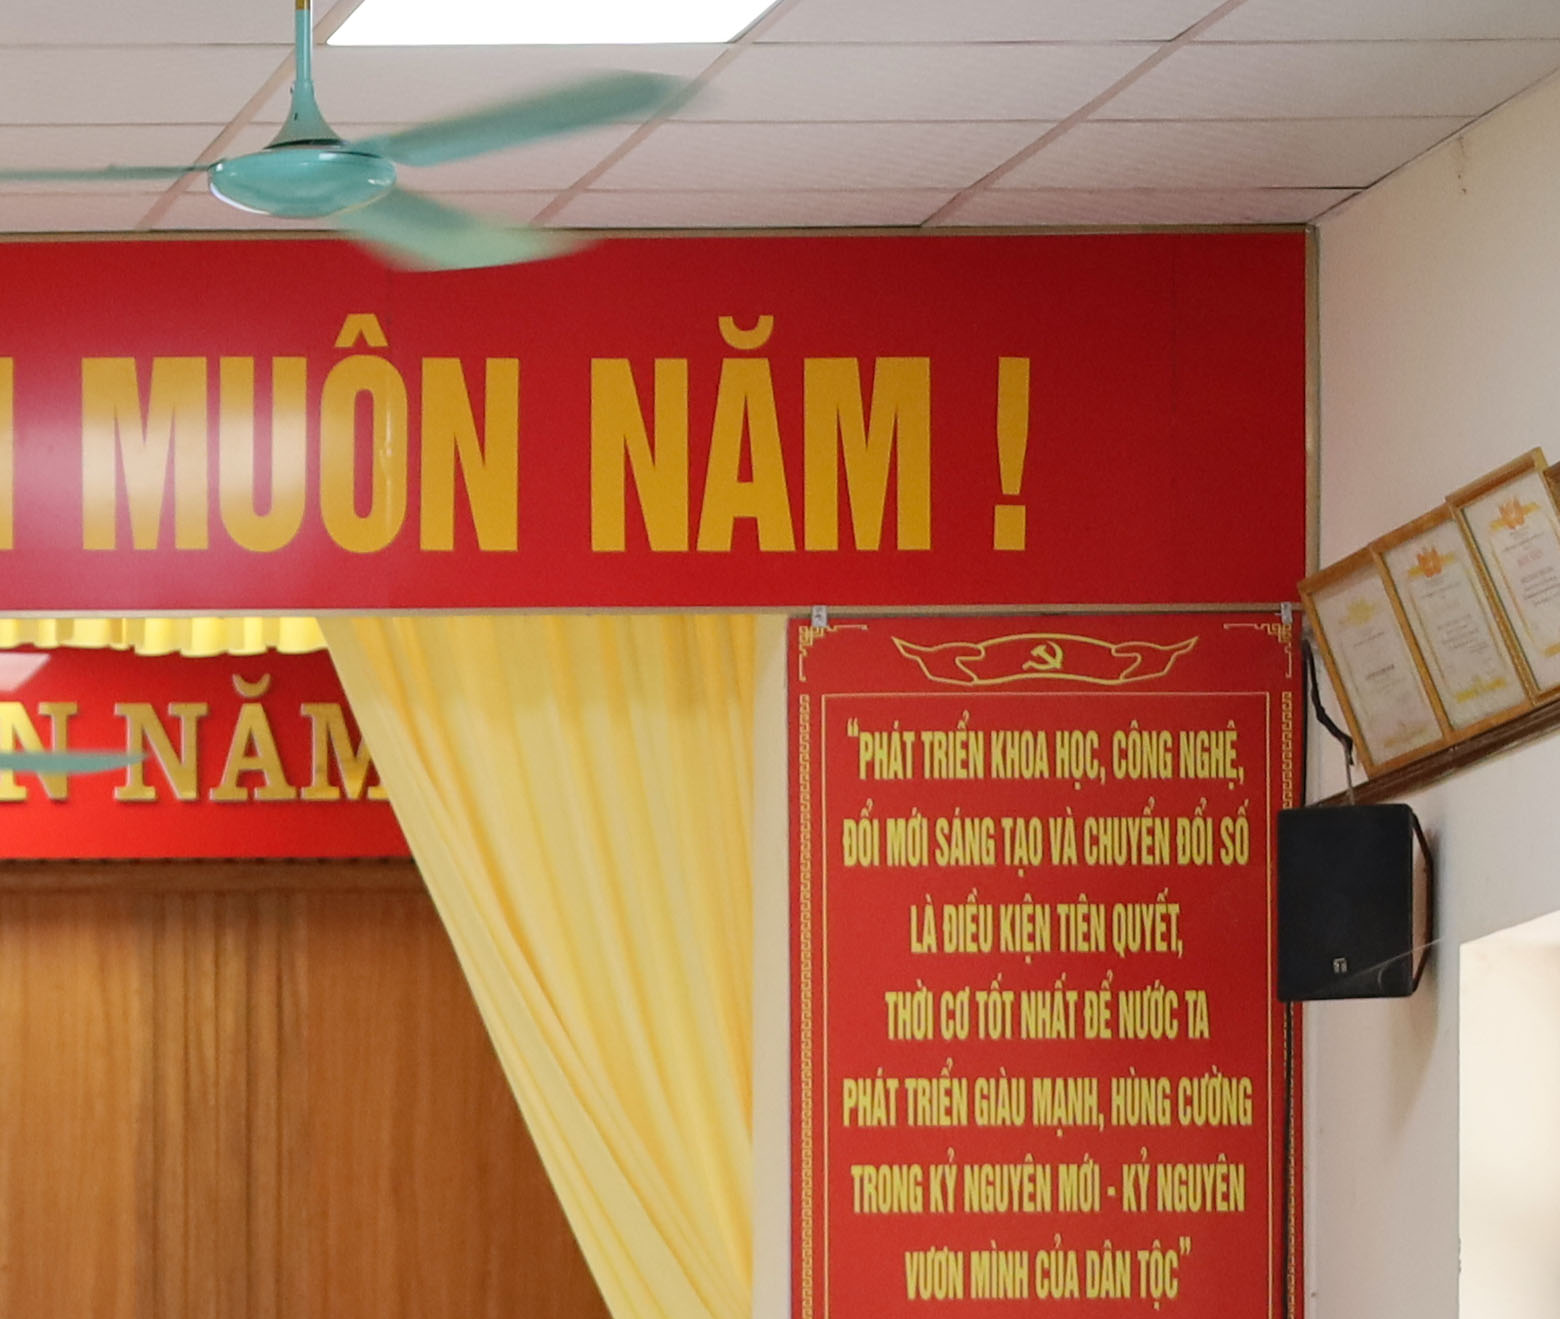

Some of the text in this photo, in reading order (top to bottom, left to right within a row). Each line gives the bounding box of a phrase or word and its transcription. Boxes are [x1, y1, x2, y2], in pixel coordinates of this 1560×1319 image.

[84, 315, 518, 552] MUÔN
[592, 317, 931, 551] NĂM
[996, 358, 1029, 550] !
[848, 711, 1243, 789] “PHÁT TRIỂN KHOA HỌC, CÔNG NGHỆ,
[911, 888, 1182, 963] LÀ ĐIỀU KIỆN TIÊN QUYẾT,
[851, 1147, 1244, 1214] TRONG KỶ NGUYÊN MỚI KỶ NGUYÊN
[905, 1234, 1190, 1309] VƯƠN MÌNH CỦA DÂN TỘC”
